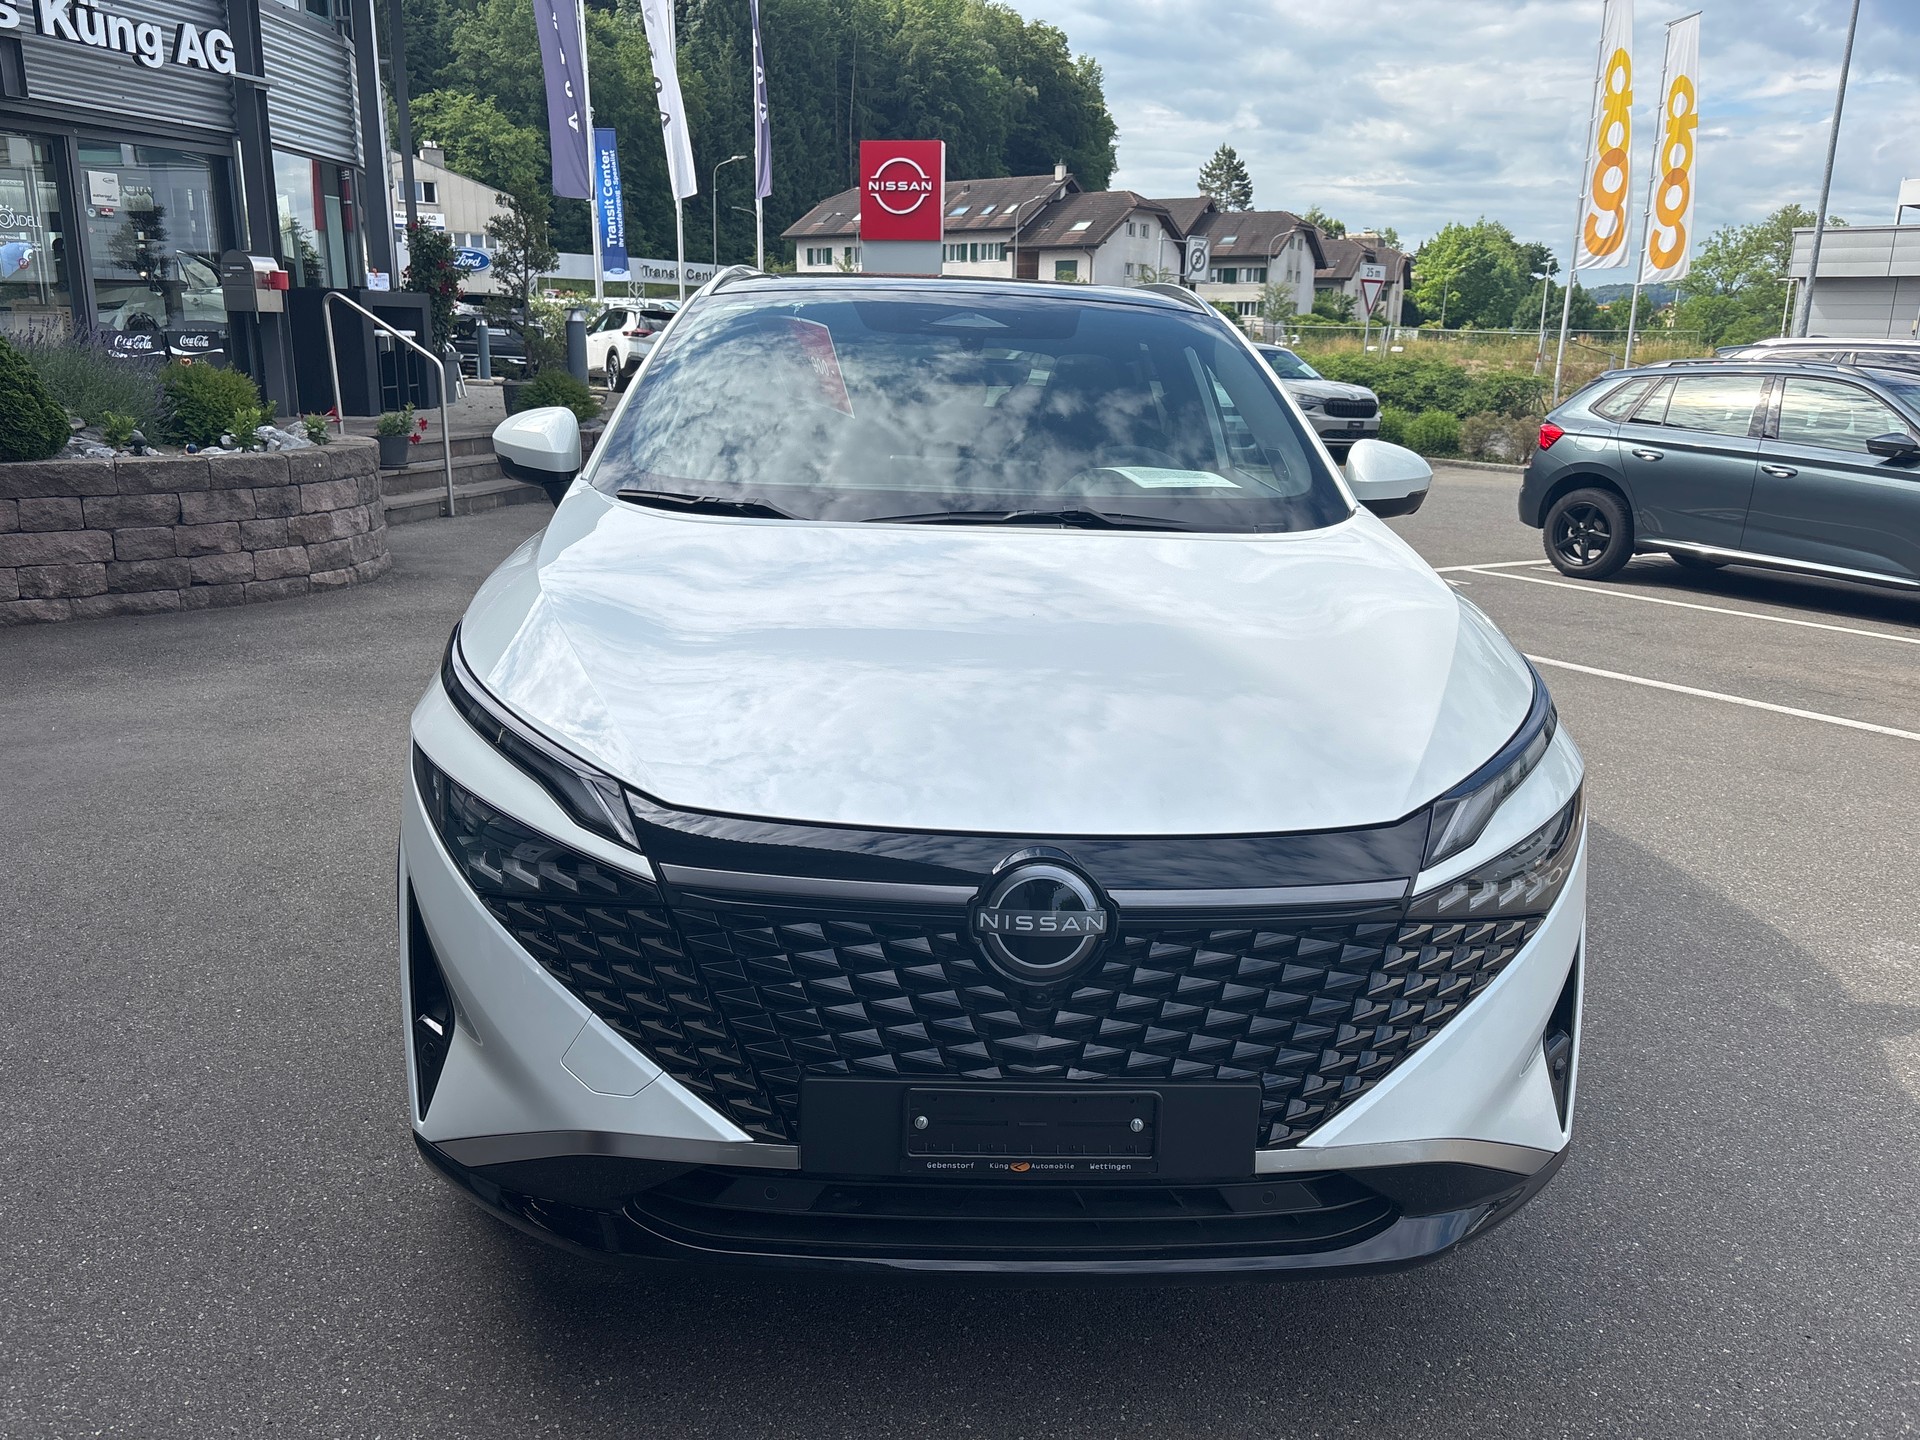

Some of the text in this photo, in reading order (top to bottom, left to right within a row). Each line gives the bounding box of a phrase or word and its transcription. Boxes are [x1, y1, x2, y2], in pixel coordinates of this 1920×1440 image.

[41, 0, 164, 69] Küng
[178, 23, 236, 75] AG
[1584, 48, 1633, 256] coop
[1649, 74, 1698, 270] coop
[868, 181, 932, 191] NISSAN
[601, 149, 617, 248] Transit Center
[454, 252, 482, 267] Ford
[642, 264, 717, 282] Transi Cent
[1366, 267, 1374, 277] 25
[980, 913, 1104, 932] NISSAN
[926, 1161, 1131, 1171] Gebenstorf Küng Automobile Wettingen
